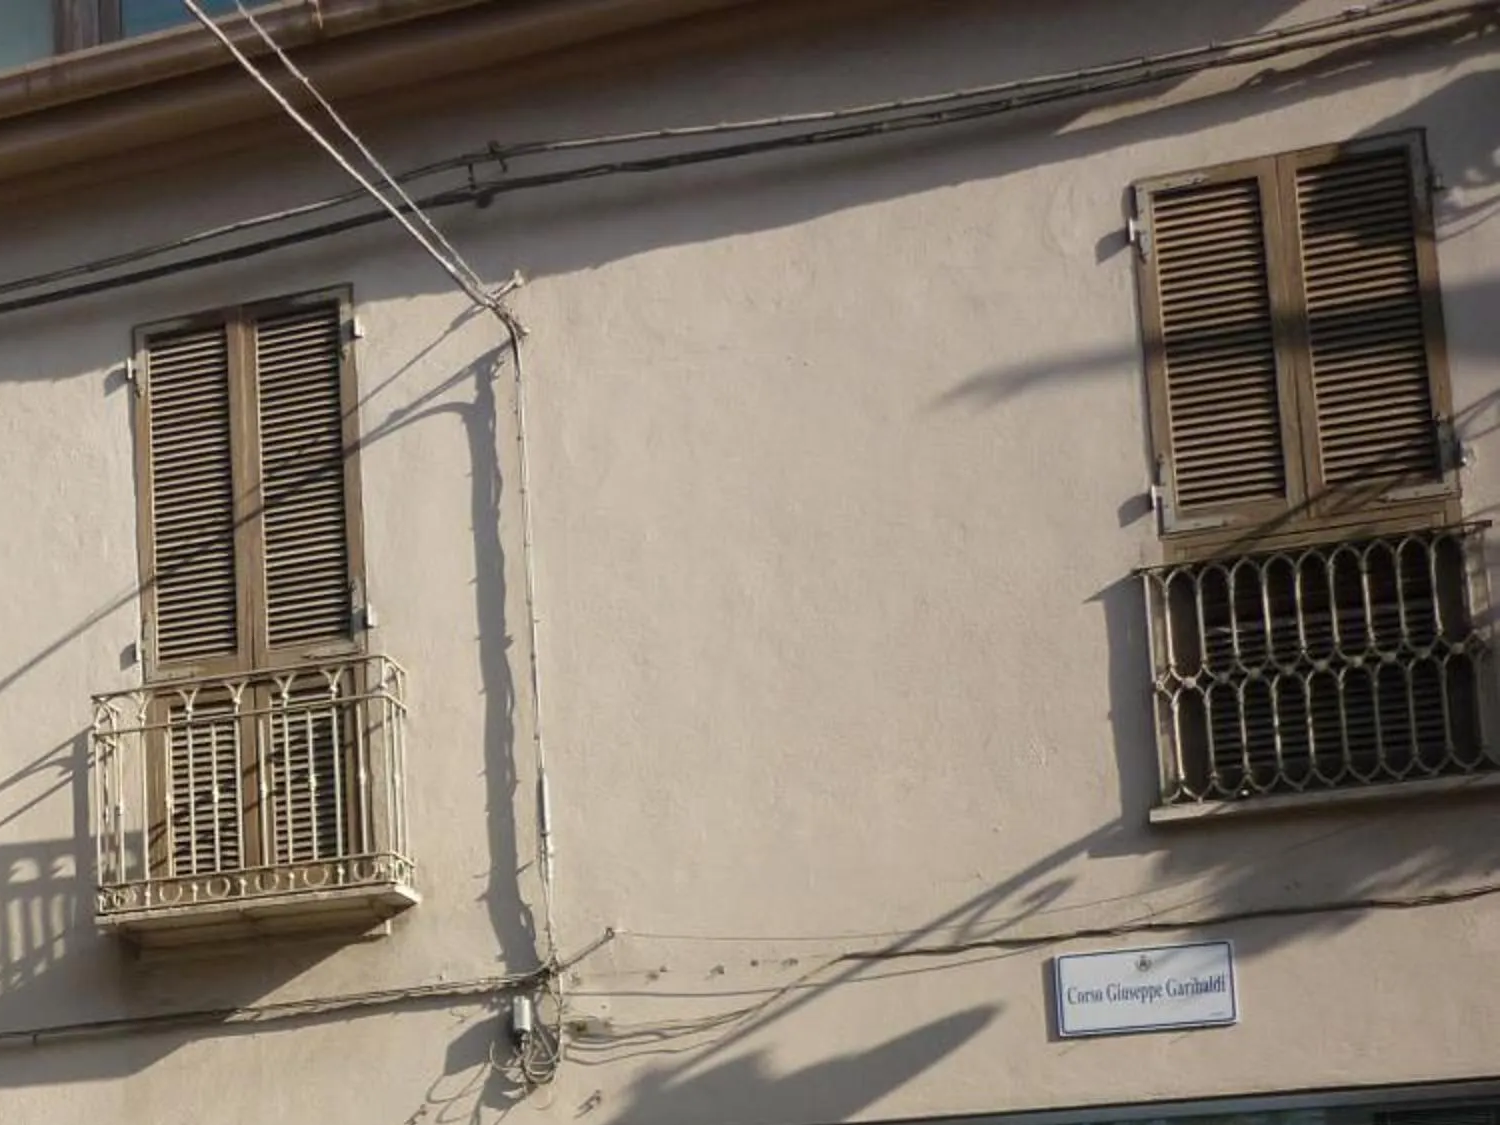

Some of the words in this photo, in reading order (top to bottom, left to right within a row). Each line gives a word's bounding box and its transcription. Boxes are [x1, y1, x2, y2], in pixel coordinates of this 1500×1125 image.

[1067, 986, 1103, 1005] Corso
[1106, 982, 1163, 1004] Giuseppe
[1165, 972, 1227, 998] Garibaldi
